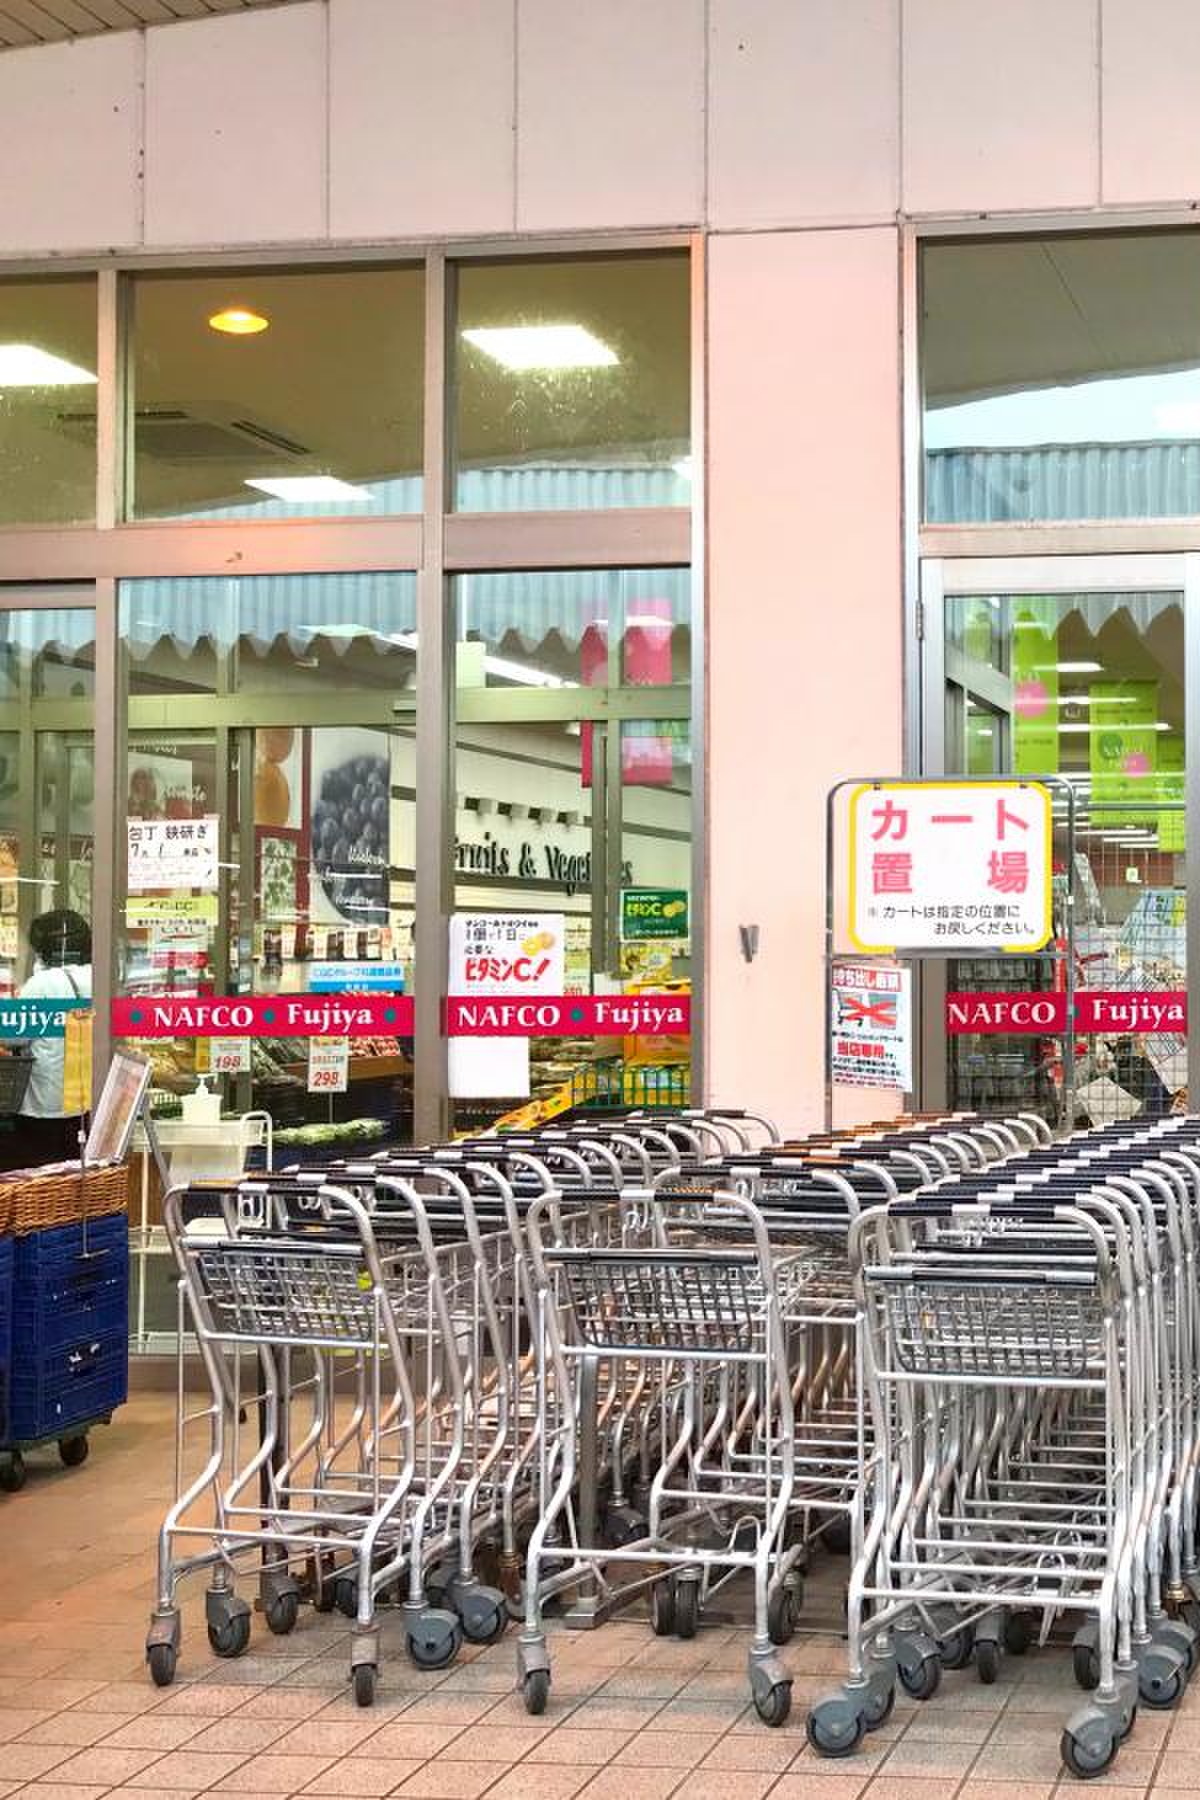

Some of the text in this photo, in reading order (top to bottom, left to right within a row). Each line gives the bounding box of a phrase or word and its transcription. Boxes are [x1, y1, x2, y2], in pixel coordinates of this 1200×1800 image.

[870, 799, 1030, 841] カート
[871, 850, 1030, 895] 置場
[933, 920, 1035, 936] お戻しください。
[153, 1003, 374, 1033] NAFCO Fujiya
[457, 1001, 684, 1033] NAFCO Fujiya
[948, 999, 1184, 1028] NAFCO Fujiya
